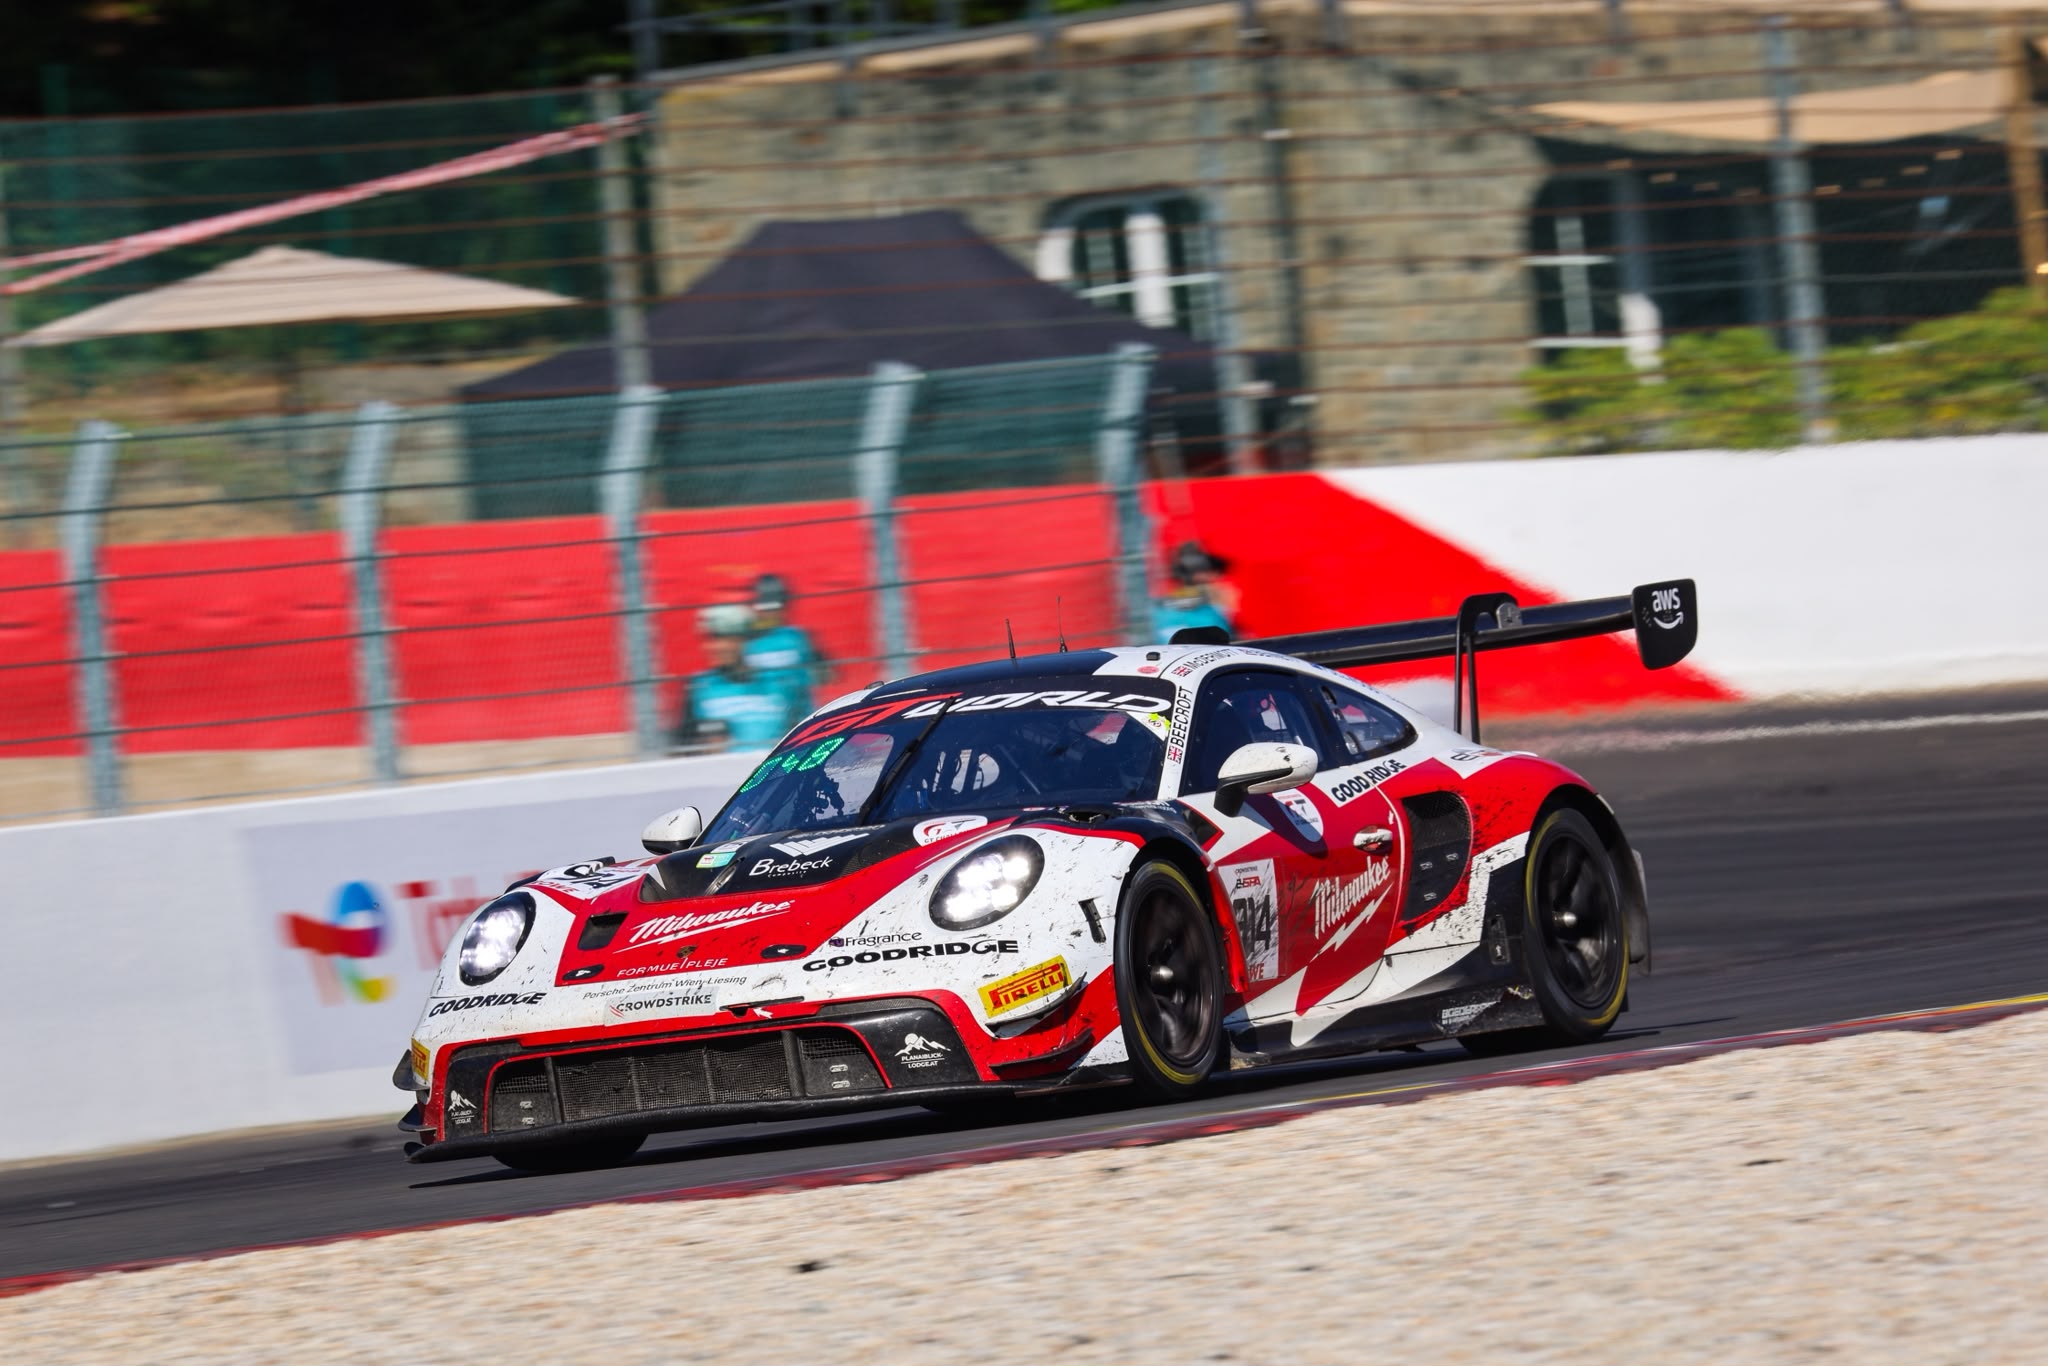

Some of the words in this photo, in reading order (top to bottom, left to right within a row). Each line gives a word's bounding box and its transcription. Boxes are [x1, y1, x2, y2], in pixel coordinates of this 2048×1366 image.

[1651, 587, 1681, 612] aws
[901, 690, 1173, 719] WORLD
[1169, 686, 1193, 749] BEECROFT
[748, 856, 834, 876] Brebeck
[1311, 856, 1392, 940] Milwaukee
[630, 900, 796, 943] Milwaukee
[845, 931, 923, 947] Fragrance
[802, 940, 1019, 972] GOODRIDGE
[583, 986, 626, 1000] Porsche
[627, 979, 673, 993] Zentrum
[988, 962, 1065, 1010] PIRELLI
[428, 992, 548, 1018] GOODRIDGE
[617, 994, 712, 1012] CROWDSTRIKE
